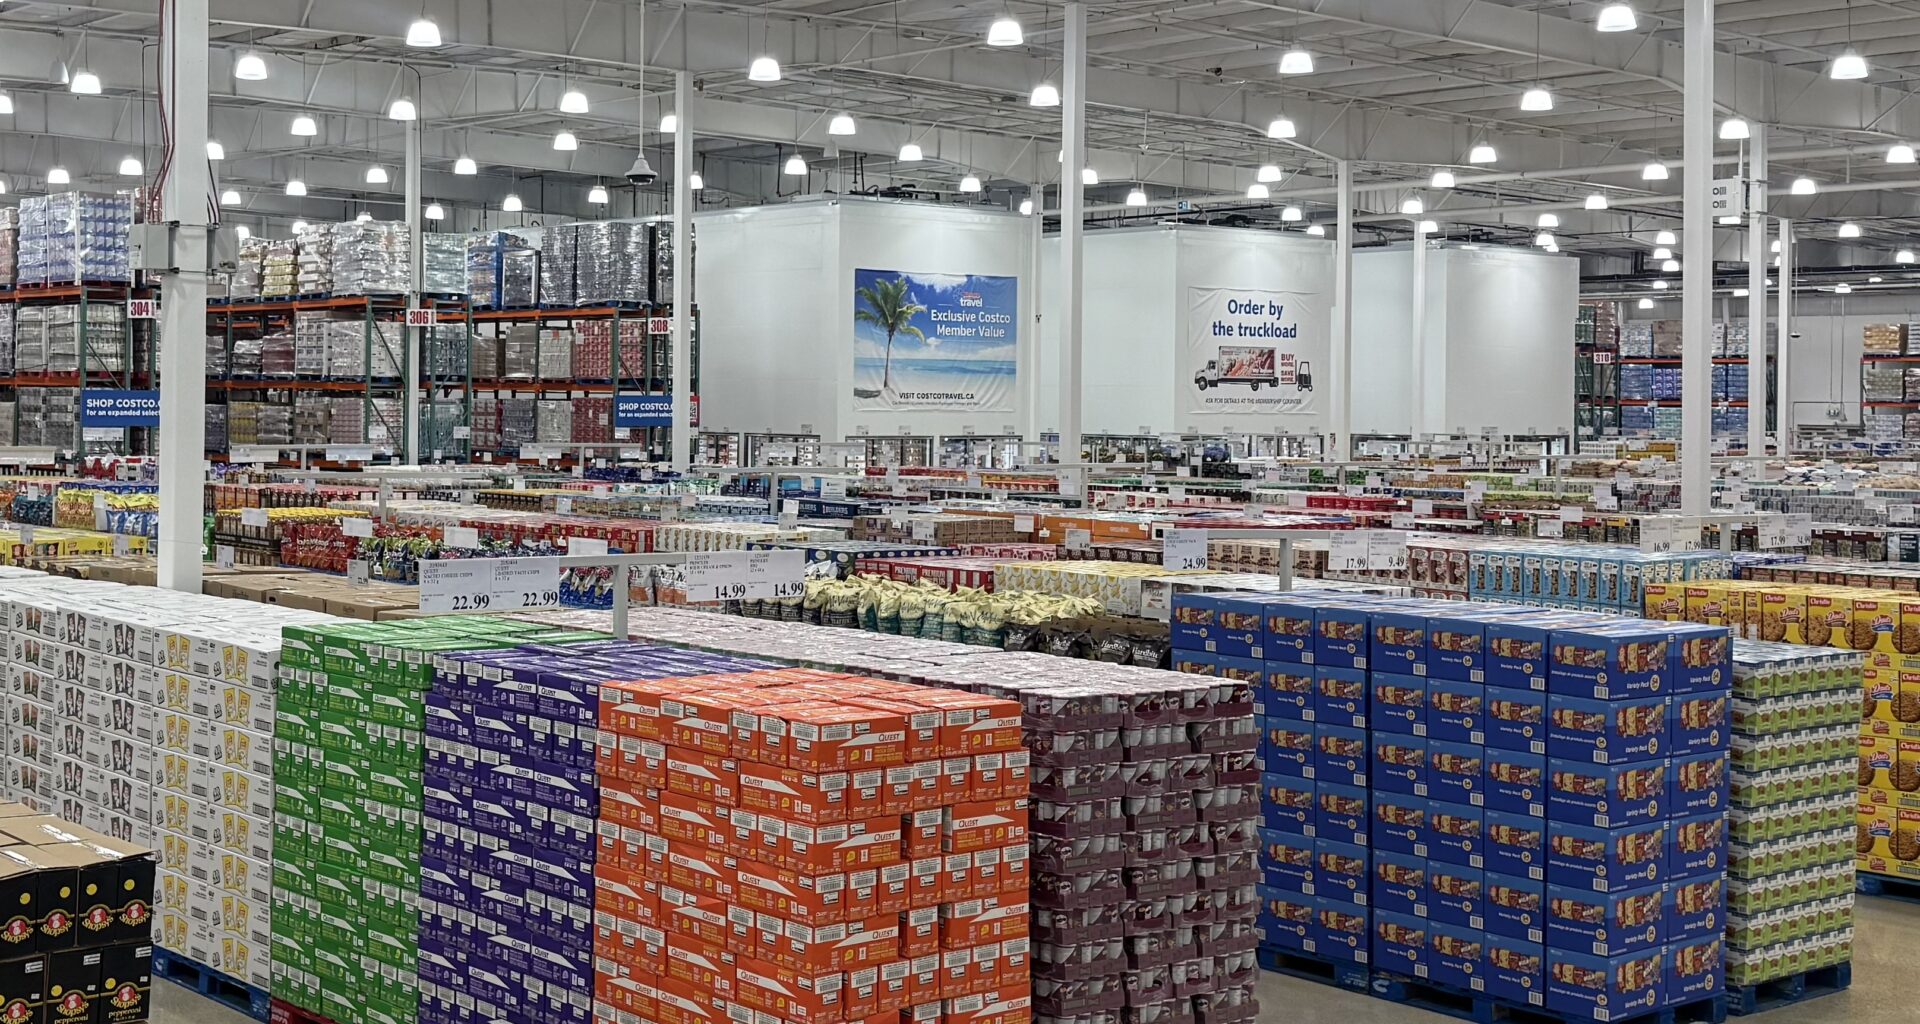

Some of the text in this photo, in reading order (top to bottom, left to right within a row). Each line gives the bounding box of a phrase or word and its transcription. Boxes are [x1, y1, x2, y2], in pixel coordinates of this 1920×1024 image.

[960, 298, 982, 307] travel
[130, 302, 150, 316] 304
[1228, 299, 1283, 320] Order by
[410, 311, 429, 324] 306
[931, 310, 1010, 323] Exclusive Costco
[651, 320, 668, 332] 308
[937, 324, 1005, 337] Member Value
[1213, 320, 1297, 338] the truckload
[1595, 354, 1610, 362] 310
[87, 399, 114, 407] SHOP
[1771, 536, 1786, 546] 17.99
[1183, 558, 1206, 569] 24.99
[1346, 558, 1366, 568] 17.99
[1388, 556, 1404, 567] 9.49
[715, 584, 746, 599] 14.99
[774, 582, 804, 596] 14.99
[452, 594, 490, 610] 22.99
[522, 591, 558, 606] 22.99
[704, 722, 722, 732] QUEST
[878, 733, 900, 742] QUEST
[671, 762, 688, 771] QUEST
[744, 776, 763, 787] QUEST
[603, 789, 618, 798] QUEST
[664, 807, 681, 817] QUEST
[874, 833, 895, 842] QUEST
[673, 855, 689, 865] QUEST
[598, 880, 613, 889] QUEST
[741, 874, 760, 885] QUEST
[1006, 906, 1024, 915] QUEST
[119, 911, 150, 926] Shopsy's
[702, 912, 720, 923] QUEST
[41, 920, 72, 937] Shopsy's
[82, 916, 114, 931] Shopsy's
[1, 928, 34, 944] Shopsy's
[872, 930, 894, 939] QUEST
[671, 948, 688, 959] QUEST
[741, 971, 759, 984] QUEST
[635, 984, 652, 995] QUEST
[110, 994, 141, 1009] Shopsy's
[661, 993, 678, 1004] QUEST
[56, 1001, 89, 1016] Shopsy's
[1008, 1000, 1026, 1009] QUEST
[108, 1007, 141, 1019] pepperoni
